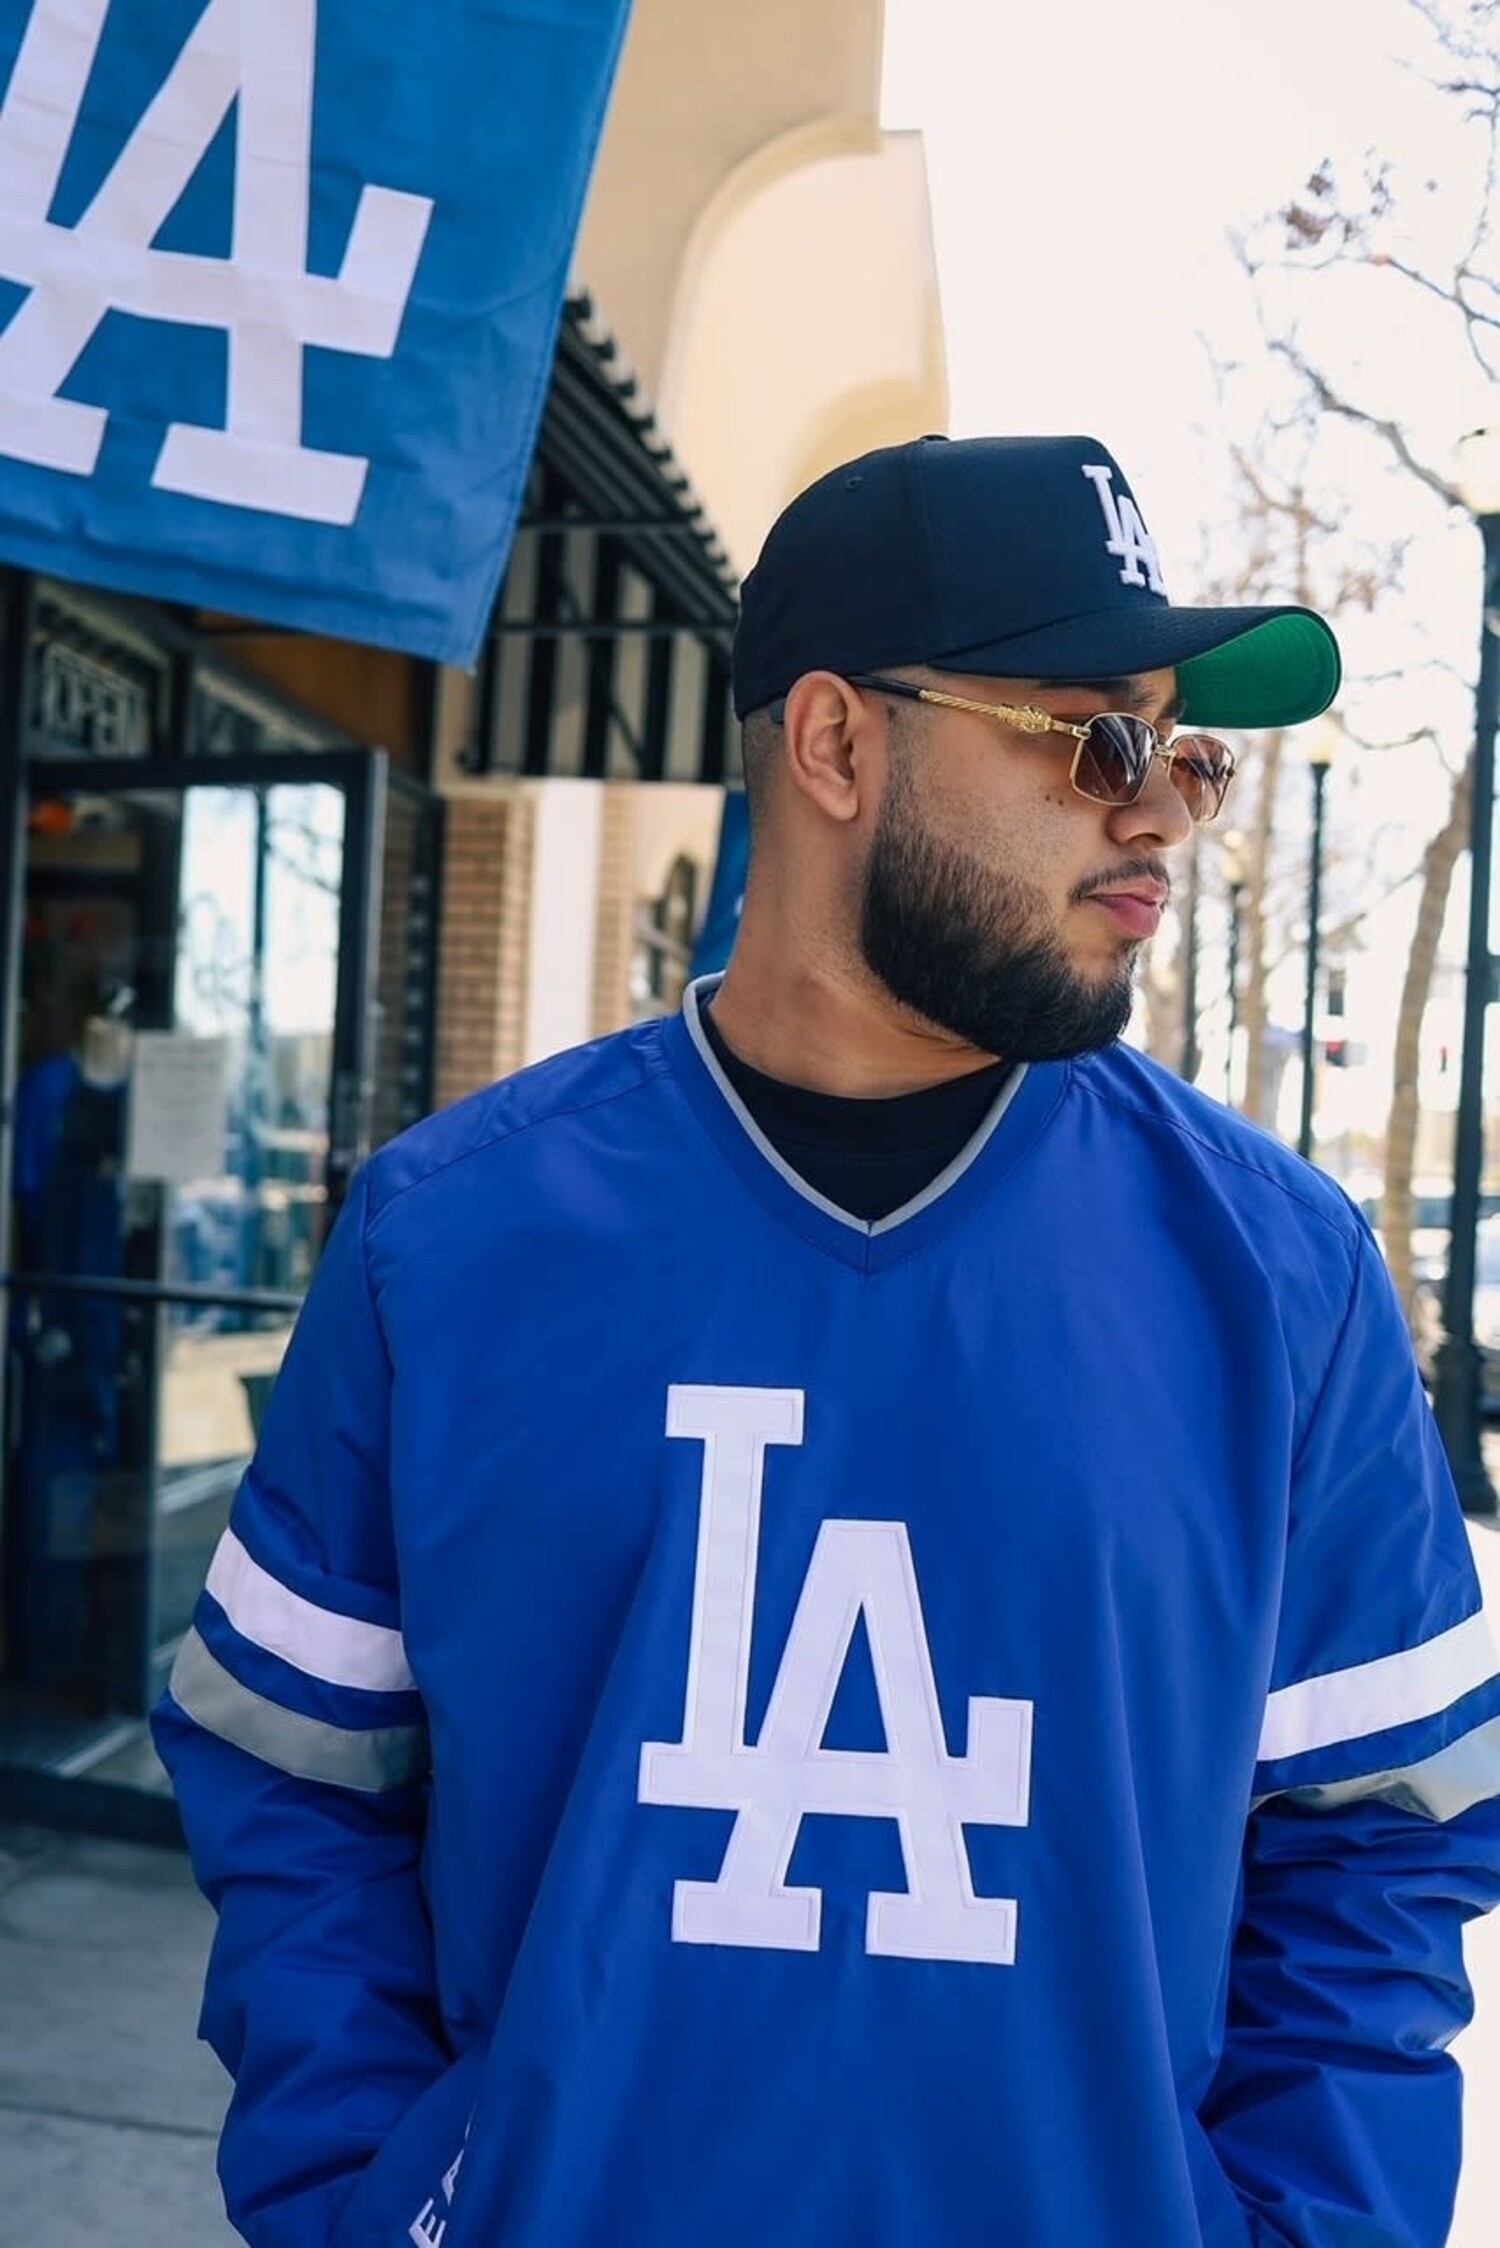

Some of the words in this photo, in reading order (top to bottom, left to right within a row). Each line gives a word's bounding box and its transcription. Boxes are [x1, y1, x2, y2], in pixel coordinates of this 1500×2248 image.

[0, 0, 434, 526] LA
[1081, 464, 1167, 597] LA
[638, 1385, 1033, 1965] LA
